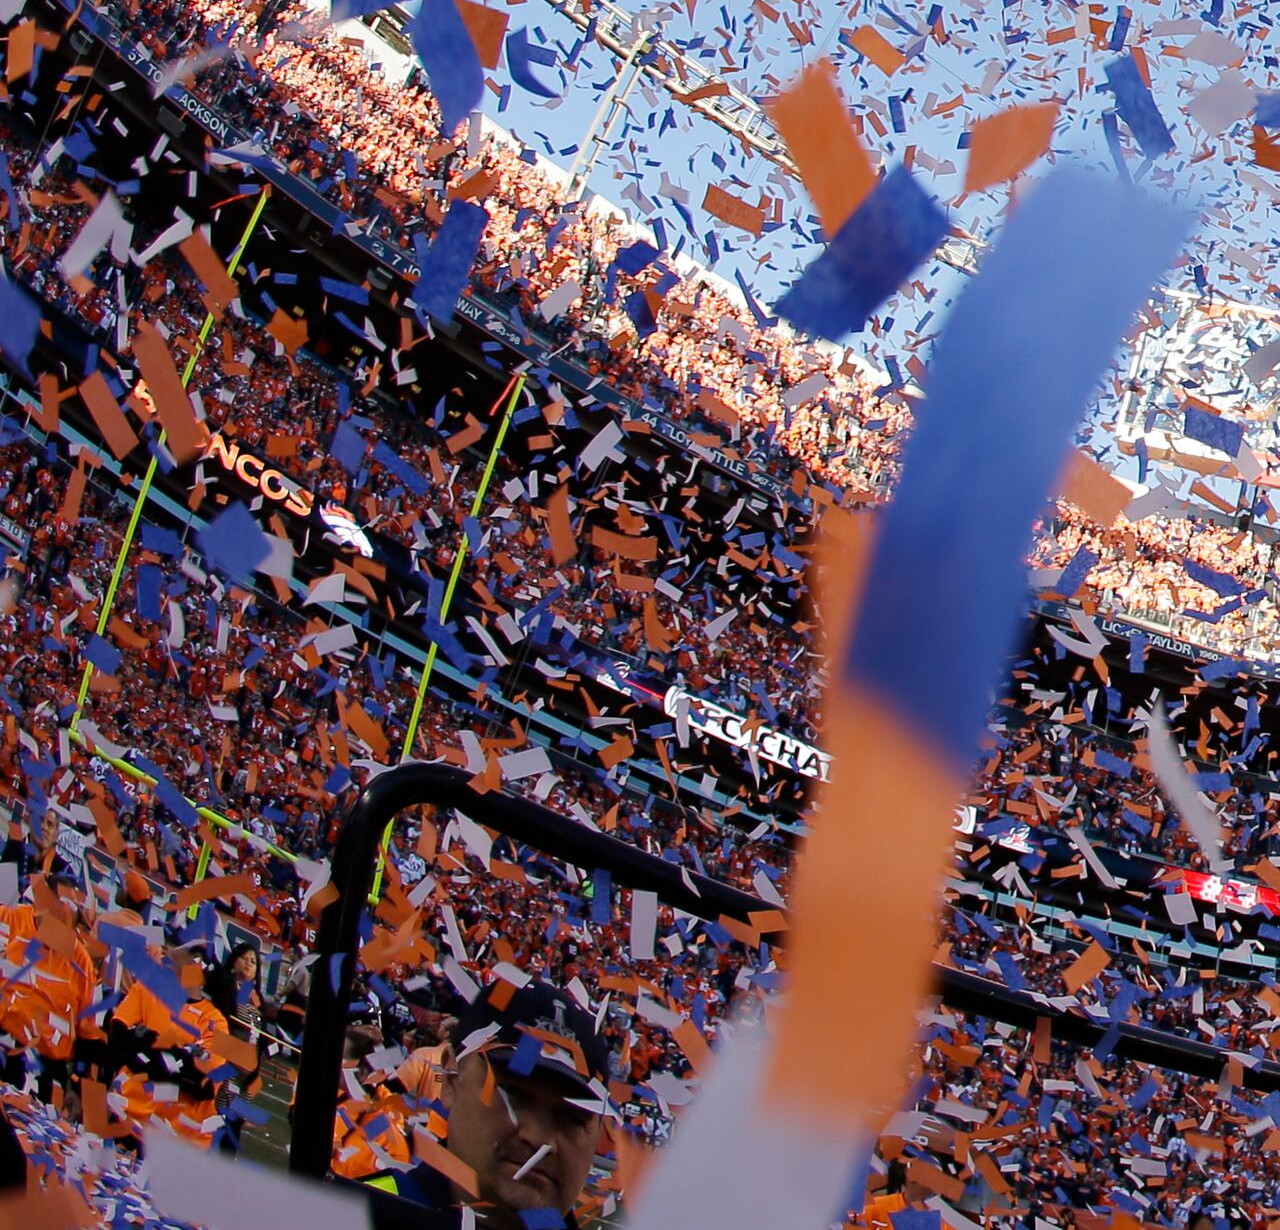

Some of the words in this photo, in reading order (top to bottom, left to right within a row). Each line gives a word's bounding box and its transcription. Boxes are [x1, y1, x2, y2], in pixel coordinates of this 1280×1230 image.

[173, 93, 229, 138] ACKSON
[641, 413, 658, 428] 44
[712, 450, 746, 476] TTLE
[1146, 632, 1192, 656] TAYLOR
[304, 927, 317, 943] 15
